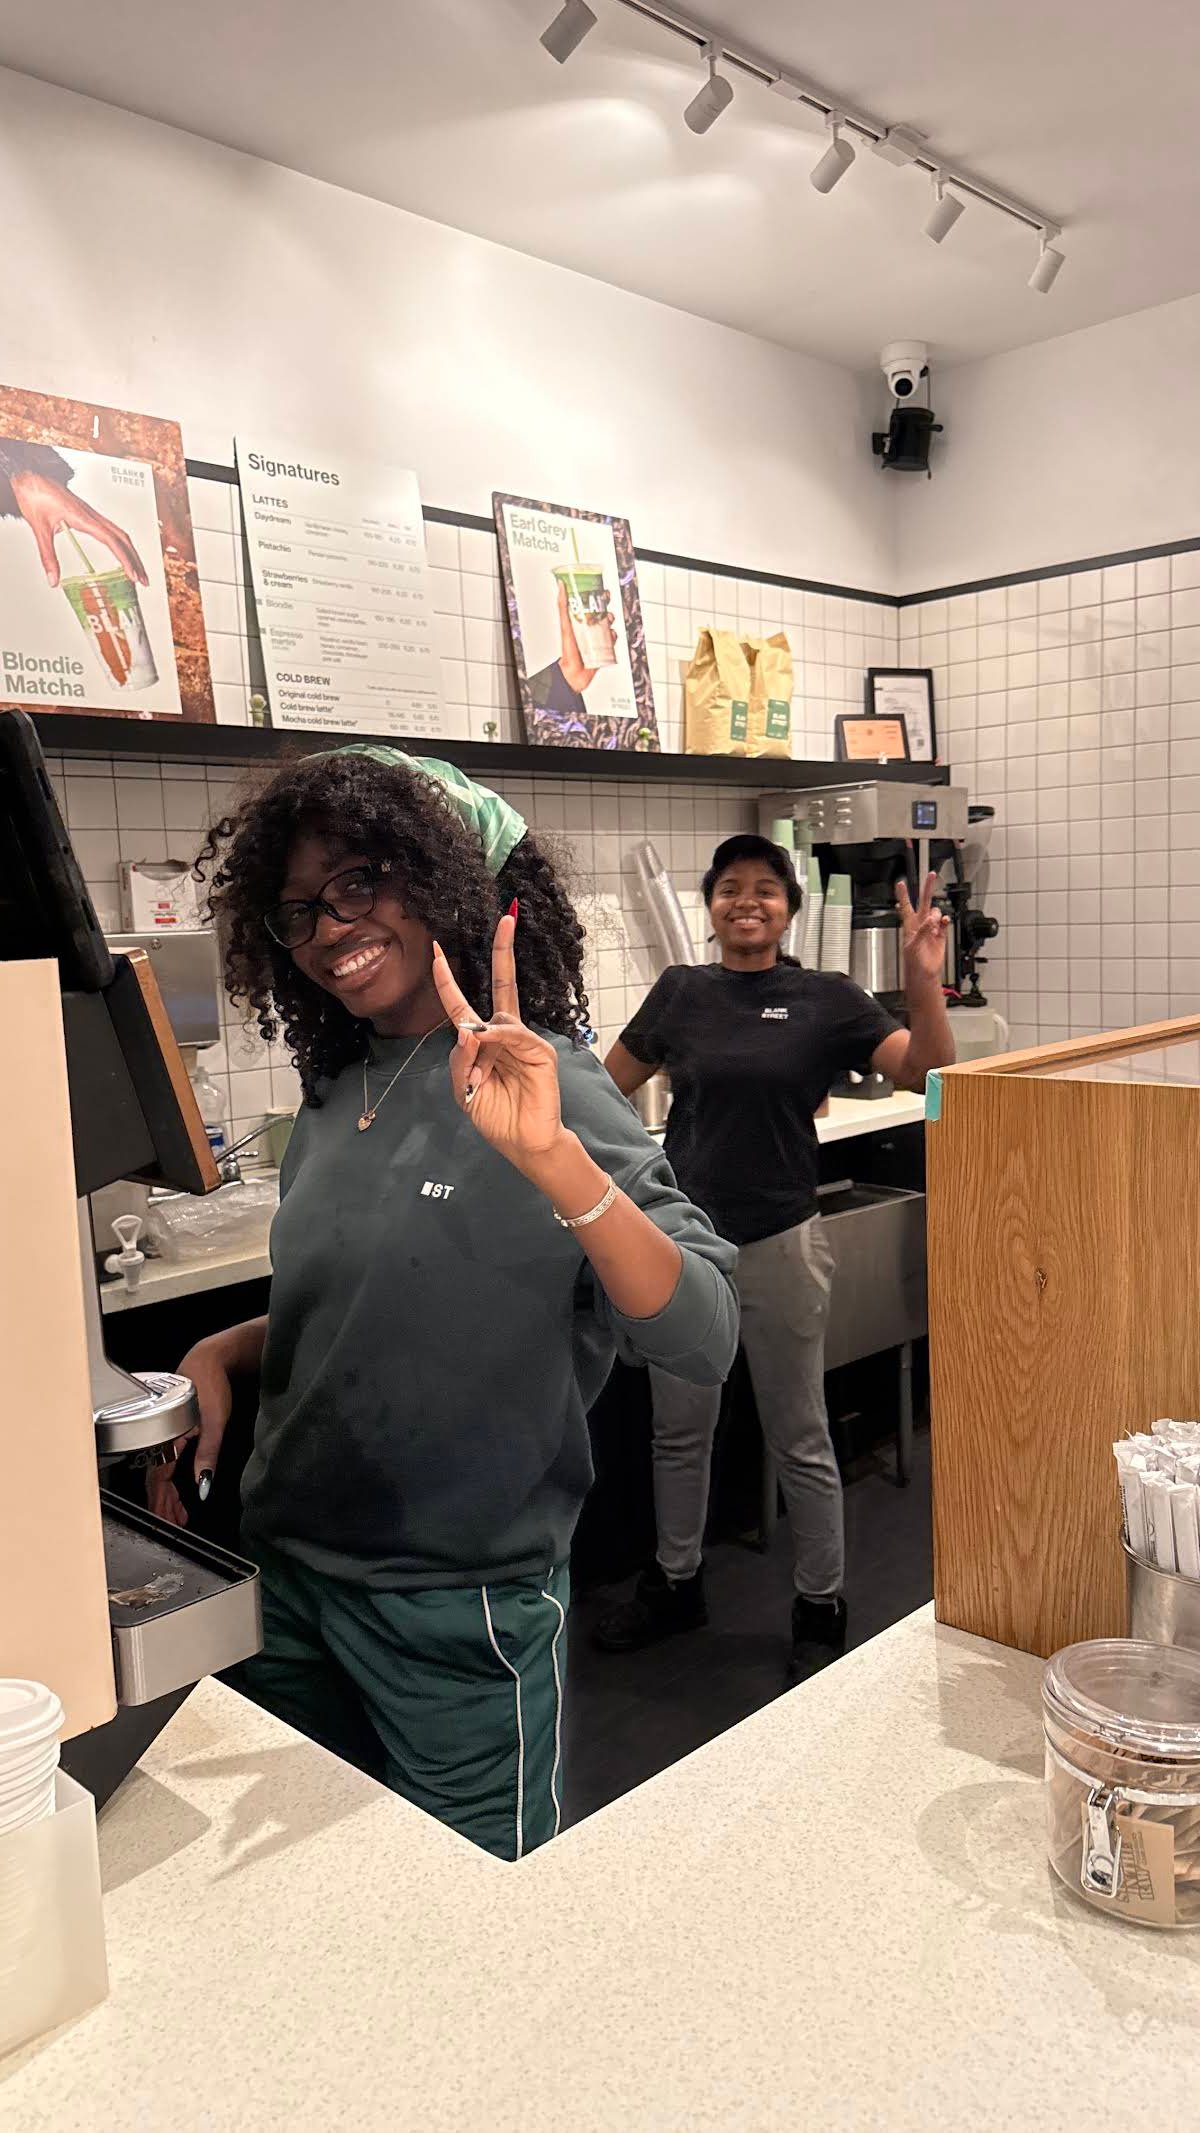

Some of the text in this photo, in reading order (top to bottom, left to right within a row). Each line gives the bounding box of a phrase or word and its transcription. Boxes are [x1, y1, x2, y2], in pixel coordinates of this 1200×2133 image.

[248, 453, 340, 486] Signatures
[252, 494, 289, 508] LATTES
[254, 512, 291, 525] Daydream
[510, 514, 567, 540] Earl Grey
[258, 540, 291, 553] Pistachio
[512, 531, 560, 552] Matcha
[262, 569, 308, 584] Strawberries
[2, 651, 84, 675] Blondie
[5, 674, 85, 697] Matcha
[276, 672, 331, 686] COLD BREW
[278, 689, 340, 702] Original cold brew
[280, 701, 297, 712] Cold
[297, 703, 315, 713] brew
[281, 714, 306, 725] Mocha
[307, 715, 323, 725] cold
[323, 717, 341, 726] brew
